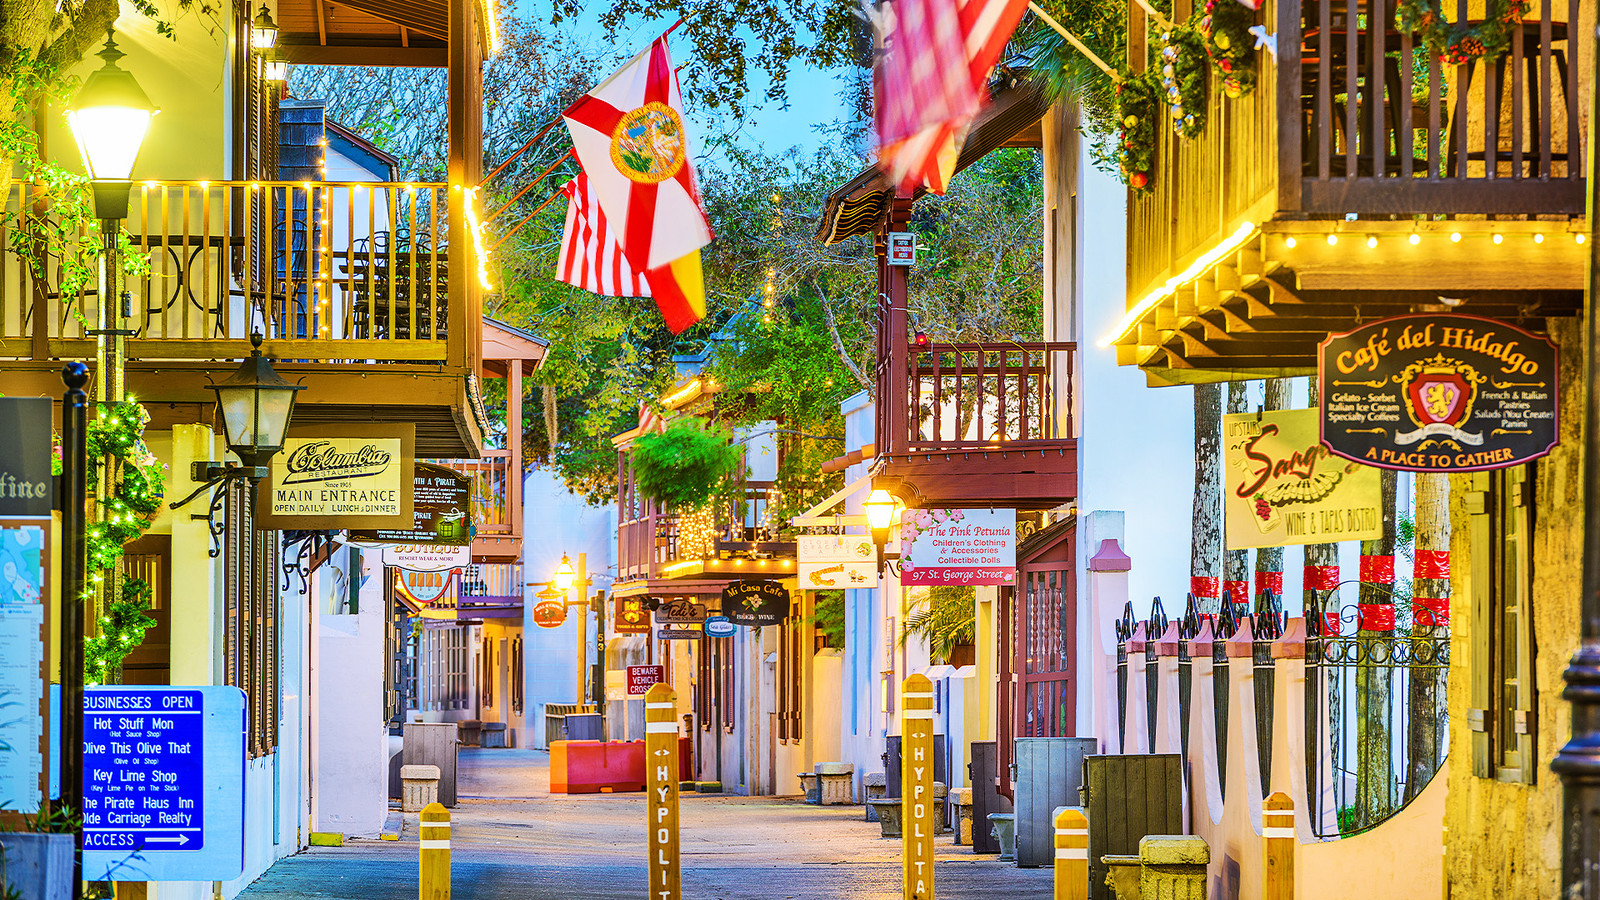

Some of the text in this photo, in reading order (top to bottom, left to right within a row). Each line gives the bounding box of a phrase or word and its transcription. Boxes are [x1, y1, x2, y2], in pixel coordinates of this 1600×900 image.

[1336, 323, 1539, 375] Café del Hidalgo
[1367, 392, 1396, 403] Sorbet
[1481, 390, 1548, 400] French & Italian
[1328, 402, 1400, 412] Italian Ice Cream
[1498, 400, 1531, 409] Pastries
[1328, 411, 1400, 424] Specialty Coffees
[1474, 409, 1502, 419] Salads
[1229, 421, 1262, 437] UPSTAIRS
[1501, 418, 1528, 428] Panini
[286, 440, 392, 474] Columbia
[1365, 446, 1515, 467] A PLACE TO GATHER
[308, 466, 368, 478] RESTAURANT
[324, 481, 339, 489] Since
[427, 477, 433, 486] A
[434, 477, 456, 488] PIRATE
[277, 490, 396, 502] MAIN ENTRANCE
[274, 504, 296, 513] OPEN
[299, 504, 325, 513] DAILY
[331, 504, 360, 513] LUNCH
[365, 504, 398, 513] DINNER
[1284, 507, 1377, 537] WINE & TAPAS BISTRO
[927, 524, 1011, 537] The Pink Petunia
[394, 544, 460, 554] BOUTIQUE
[932, 539, 1006, 548] Children's Clothing
[937, 556, 1001, 564] Collectible Dolls
[912, 569, 1004, 583] 97 St. George Street
[726, 583, 783, 598] Mi Casa Cafe
[661, 602, 698, 620] Tedi's
[736, 613, 755, 621] BEER
[632, 667, 659, 676] BEWARE
[632, 675, 659, 685] VEHICLE
[630, 685, 651, 694] CROS
[83, 696, 193, 709] BUSINESSES OPEN
[93, 717, 174, 730] Hot Stuff Mon
[109, 730, 161, 739] (Hot Sauce Shop)
[83, 741, 191, 754] Olive This Olive That
[113, 757, 160, 765] (Olive Oil Shop)
[93, 769, 177, 784] Key Lime Shop
[90, 784, 104, 792] (Key
[164, 784, 180, 792] Stick)
[83, 796, 194, 809] he Pirate Haus Inn
[107, 811, 151, 827] Carriage
[159, 811, 192, 827] Realty
[914, 747, 926, 894] HYPOLITA
[84, 833, 134, 846] ACCESS
